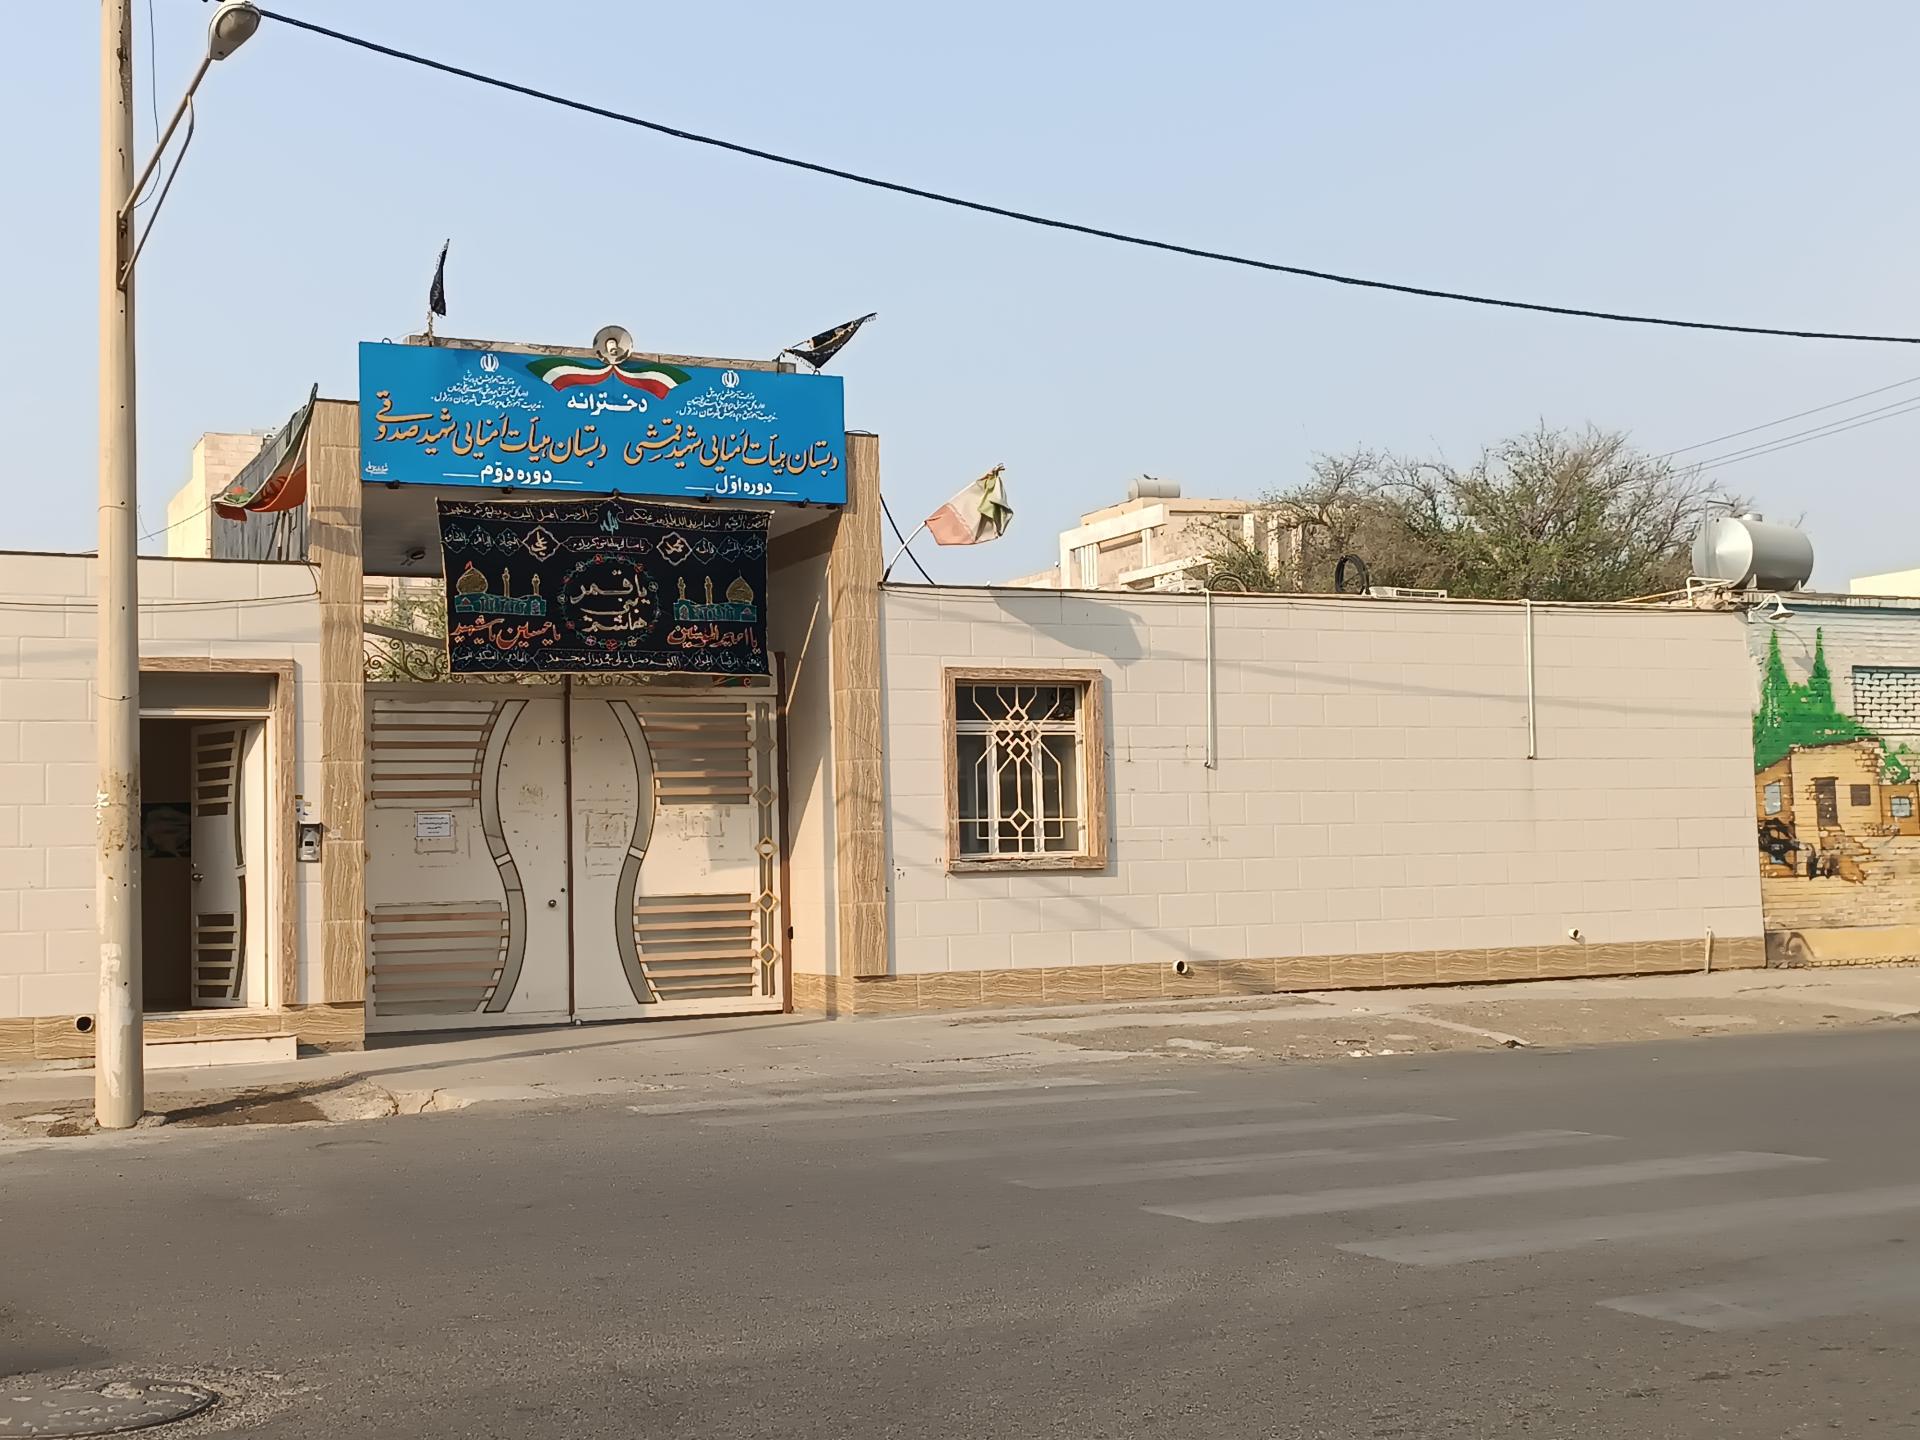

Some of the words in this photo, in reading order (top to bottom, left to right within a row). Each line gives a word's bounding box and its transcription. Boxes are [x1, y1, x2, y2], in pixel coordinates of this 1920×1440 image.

[373, 389, 434, 442] صدوقی
[567, 392, 649, 416] دخترانه
[415, 408, 457, 456] شهید
[551, 423, 608, 468] دبستان
[664, 425, 703, 469] شهید
[786, 440, 839, 478] دبستان
[516, 468, 553, 485] دوره
[743, 479, 773, 496] دوره
[570, 569, 634, 605] قمر
[635, 573, 651, 605] یا
[580, 597, 640, 618] بنی
[581, 611, 648, 633] هاشم
[495, 620, 552, 650] حسین
